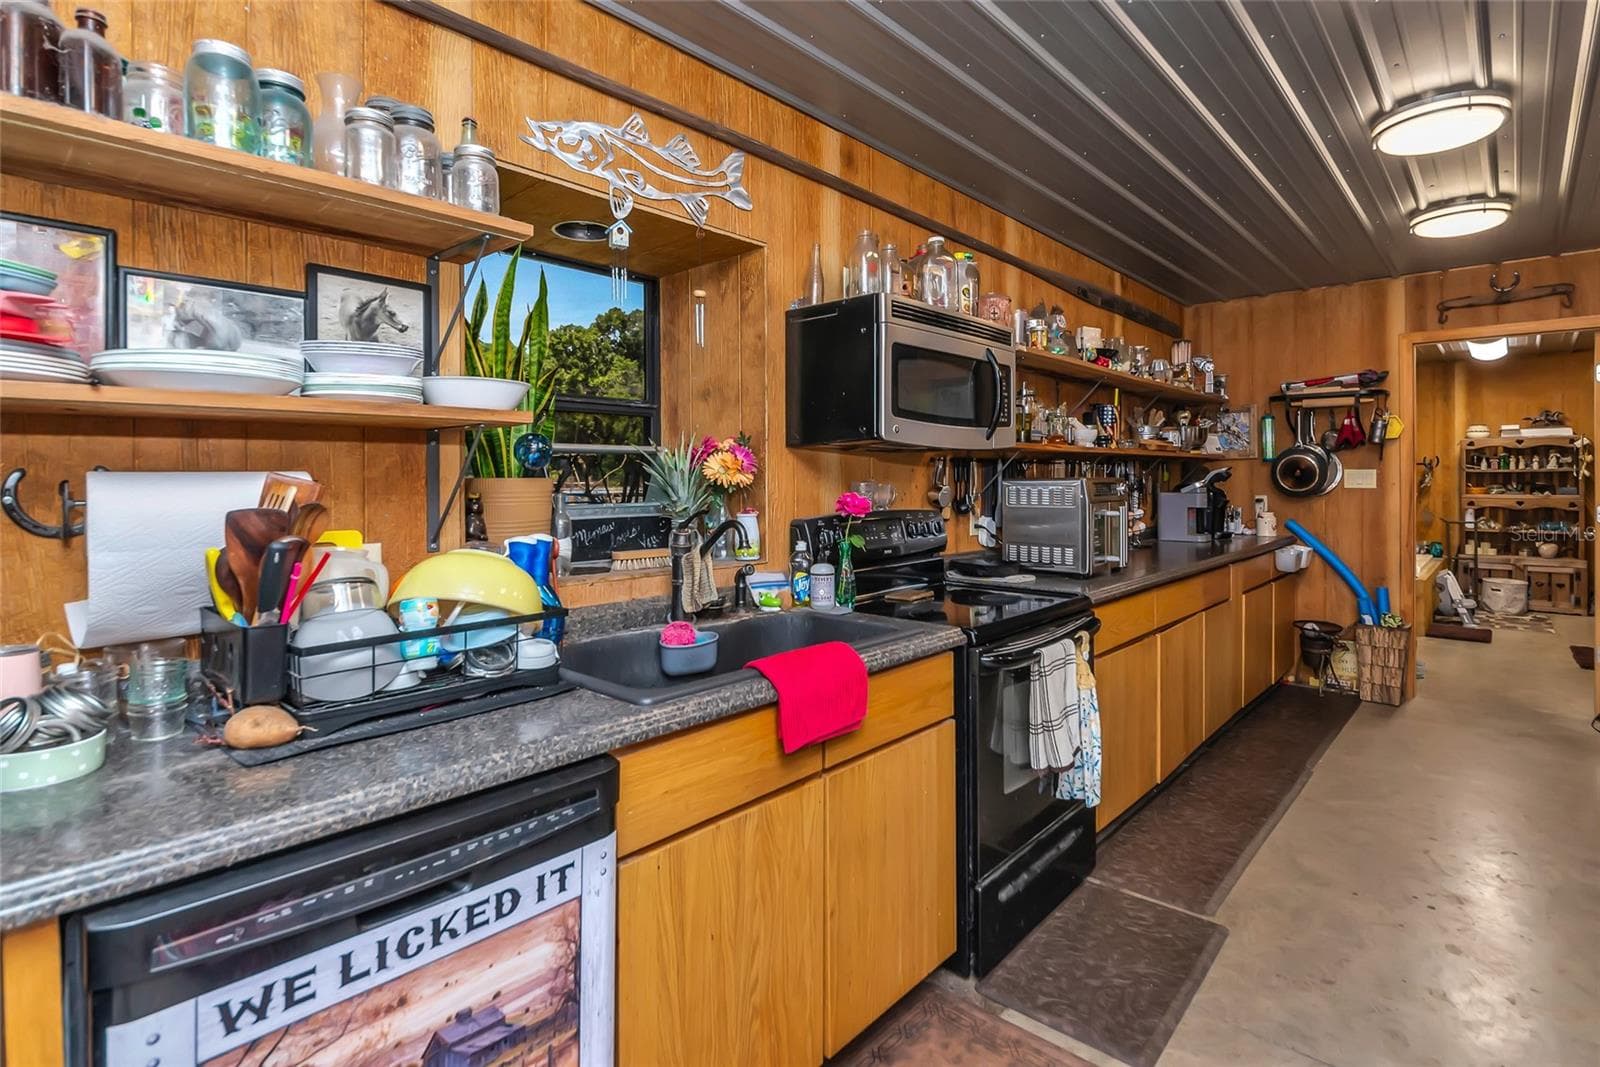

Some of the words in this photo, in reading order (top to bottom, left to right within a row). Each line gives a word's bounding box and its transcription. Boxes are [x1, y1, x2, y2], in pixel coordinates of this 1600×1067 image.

[796, 578, 810, 593] Joy
[215, 965, 317, 1038] WE
[338, 886, 522, 989] LICKED
[535, 860, 576, 904] IT
